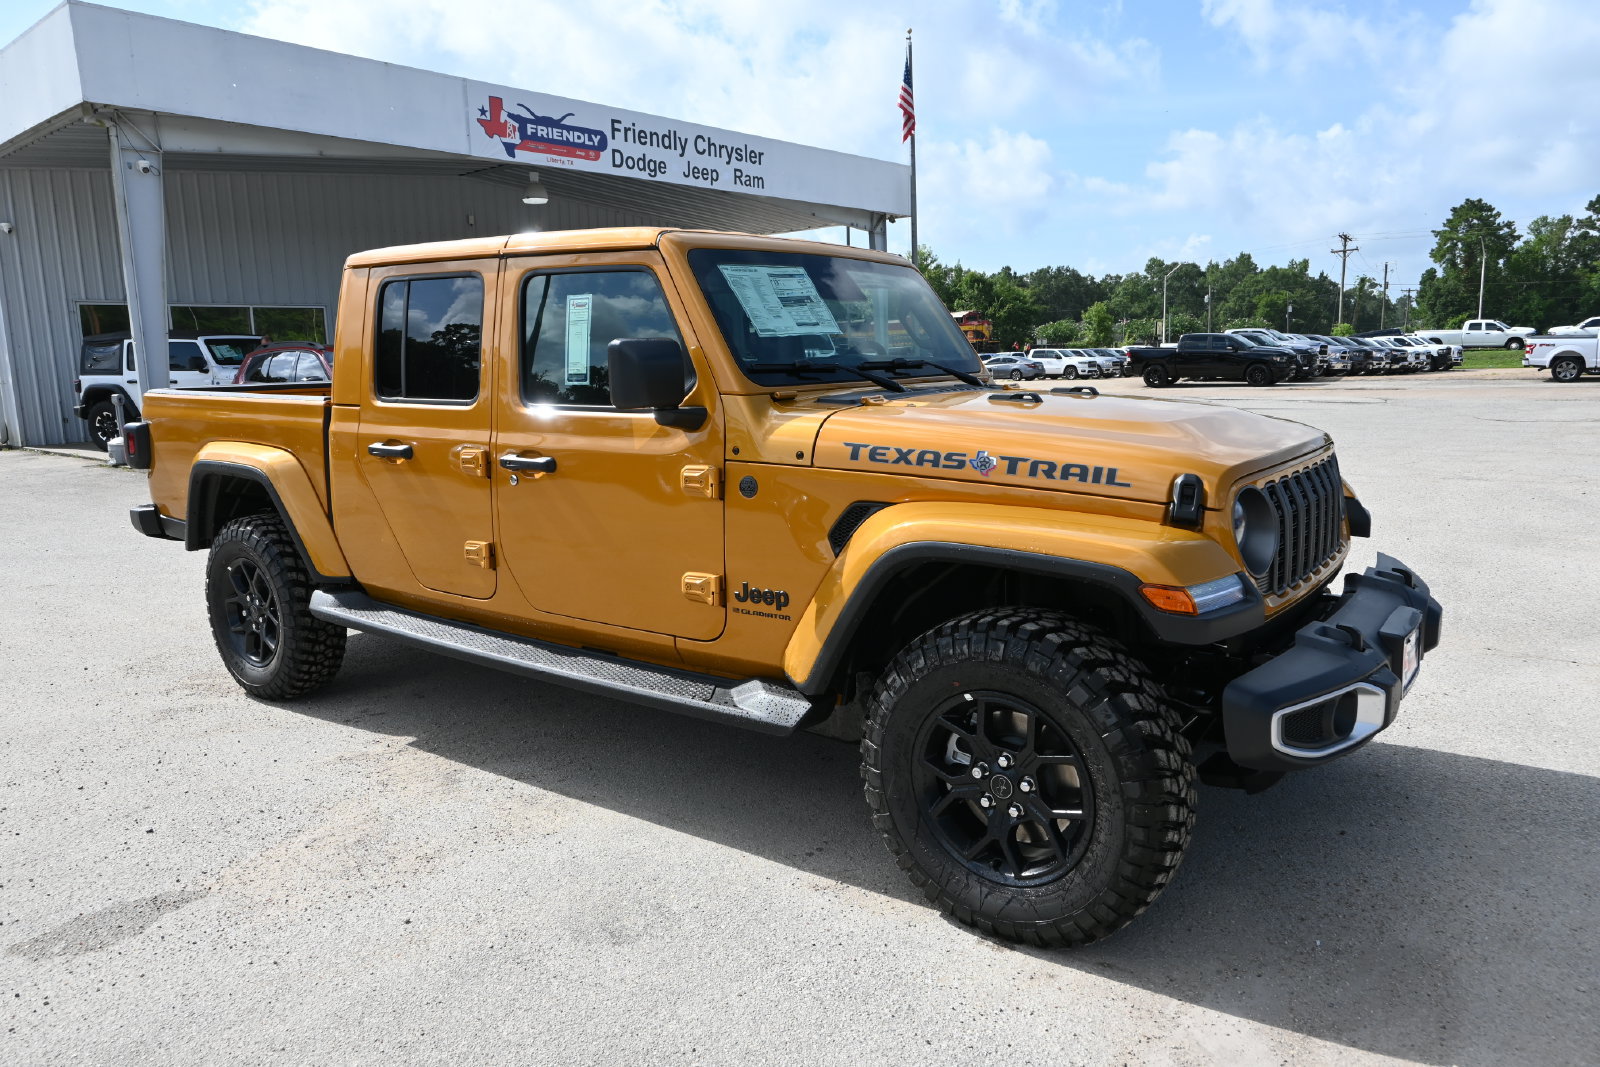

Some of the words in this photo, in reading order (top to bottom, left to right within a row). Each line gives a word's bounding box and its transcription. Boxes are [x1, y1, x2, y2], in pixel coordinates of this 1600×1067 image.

[526, 123, 601, 146] FRIENDLY
[610, 118, 688, 158] Friendly
[694, 134, 765, 165] Chrysler
[611, 149, 667, 178] Dodge
[682, 160, 720, 186] Jeep
[733, 168, 765, 189] Ram
[842, 442, 967, 470] TEXAS
[999, 455, 1132, 488] TRAIL
[734, 581, 790, 611] Jeep
[740, 608, 792, 621] GLADIATOR
